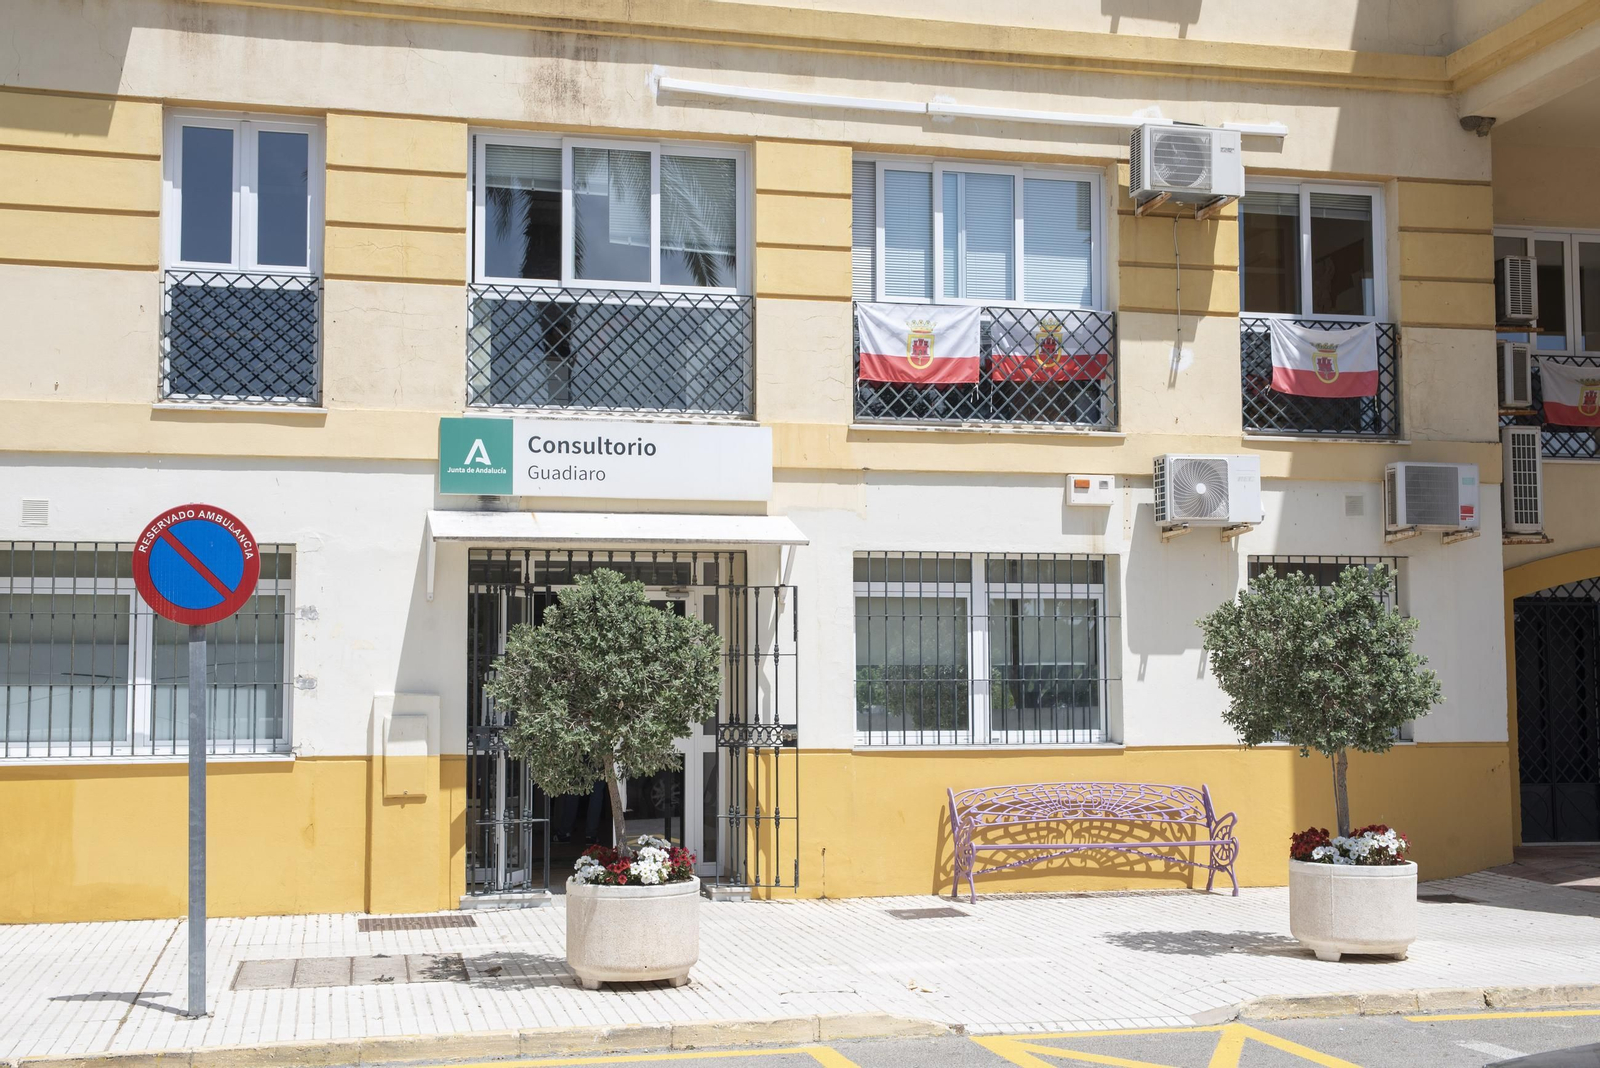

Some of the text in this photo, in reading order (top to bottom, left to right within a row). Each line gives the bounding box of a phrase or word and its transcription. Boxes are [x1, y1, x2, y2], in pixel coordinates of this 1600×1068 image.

[528, 435, 657, 457] Consultorio
[528, 465, 606, 481] Guadiaro
[138, 509, 254, 560] RESERVADO AMBULANCIA
